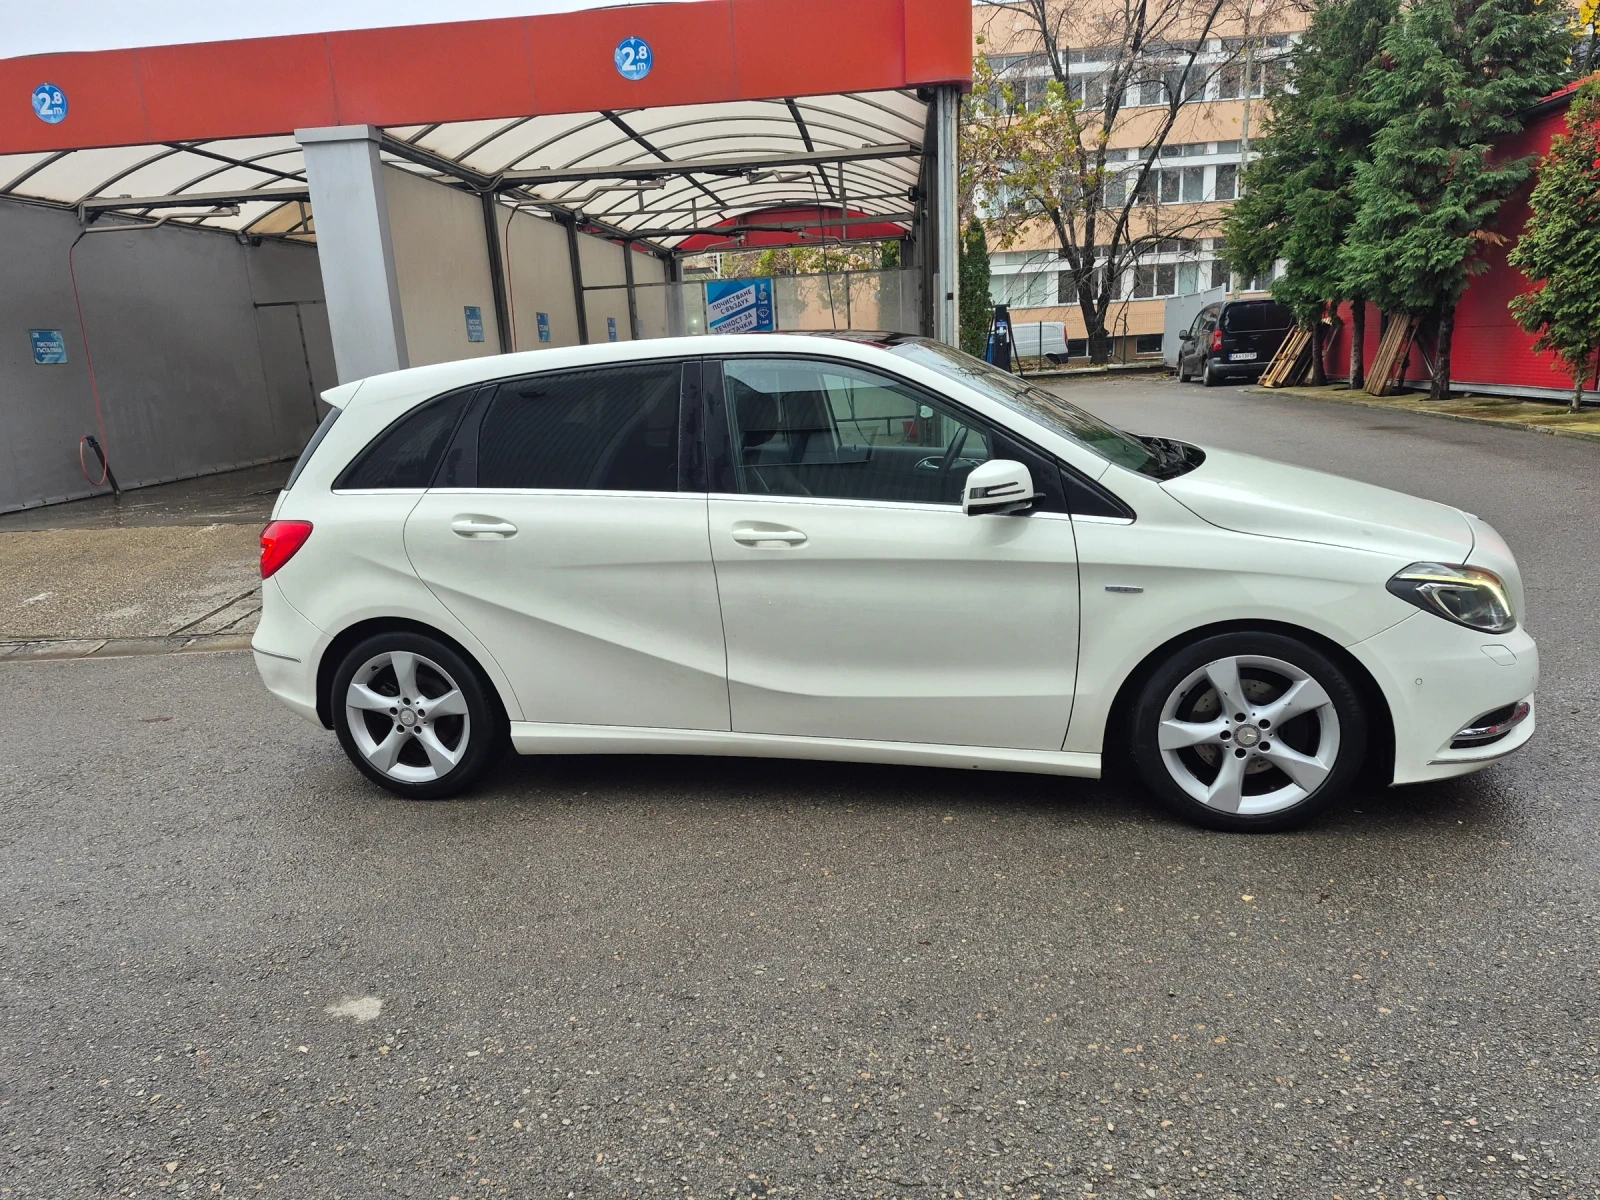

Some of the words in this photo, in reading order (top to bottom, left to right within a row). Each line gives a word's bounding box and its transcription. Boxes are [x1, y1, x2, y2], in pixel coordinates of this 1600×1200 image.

[637, 62, 646, 70] m
[712, 288, 752, 311] ПОЧИСТВАНЕ
[725, 297, 750, 314] ВЪЗДУХ
[714, 316, 742, 333] ТЕЧНОСТ
[743, 312, 753, 321] ЗА
[725, 319, 753, 333] СТАЧКИ
